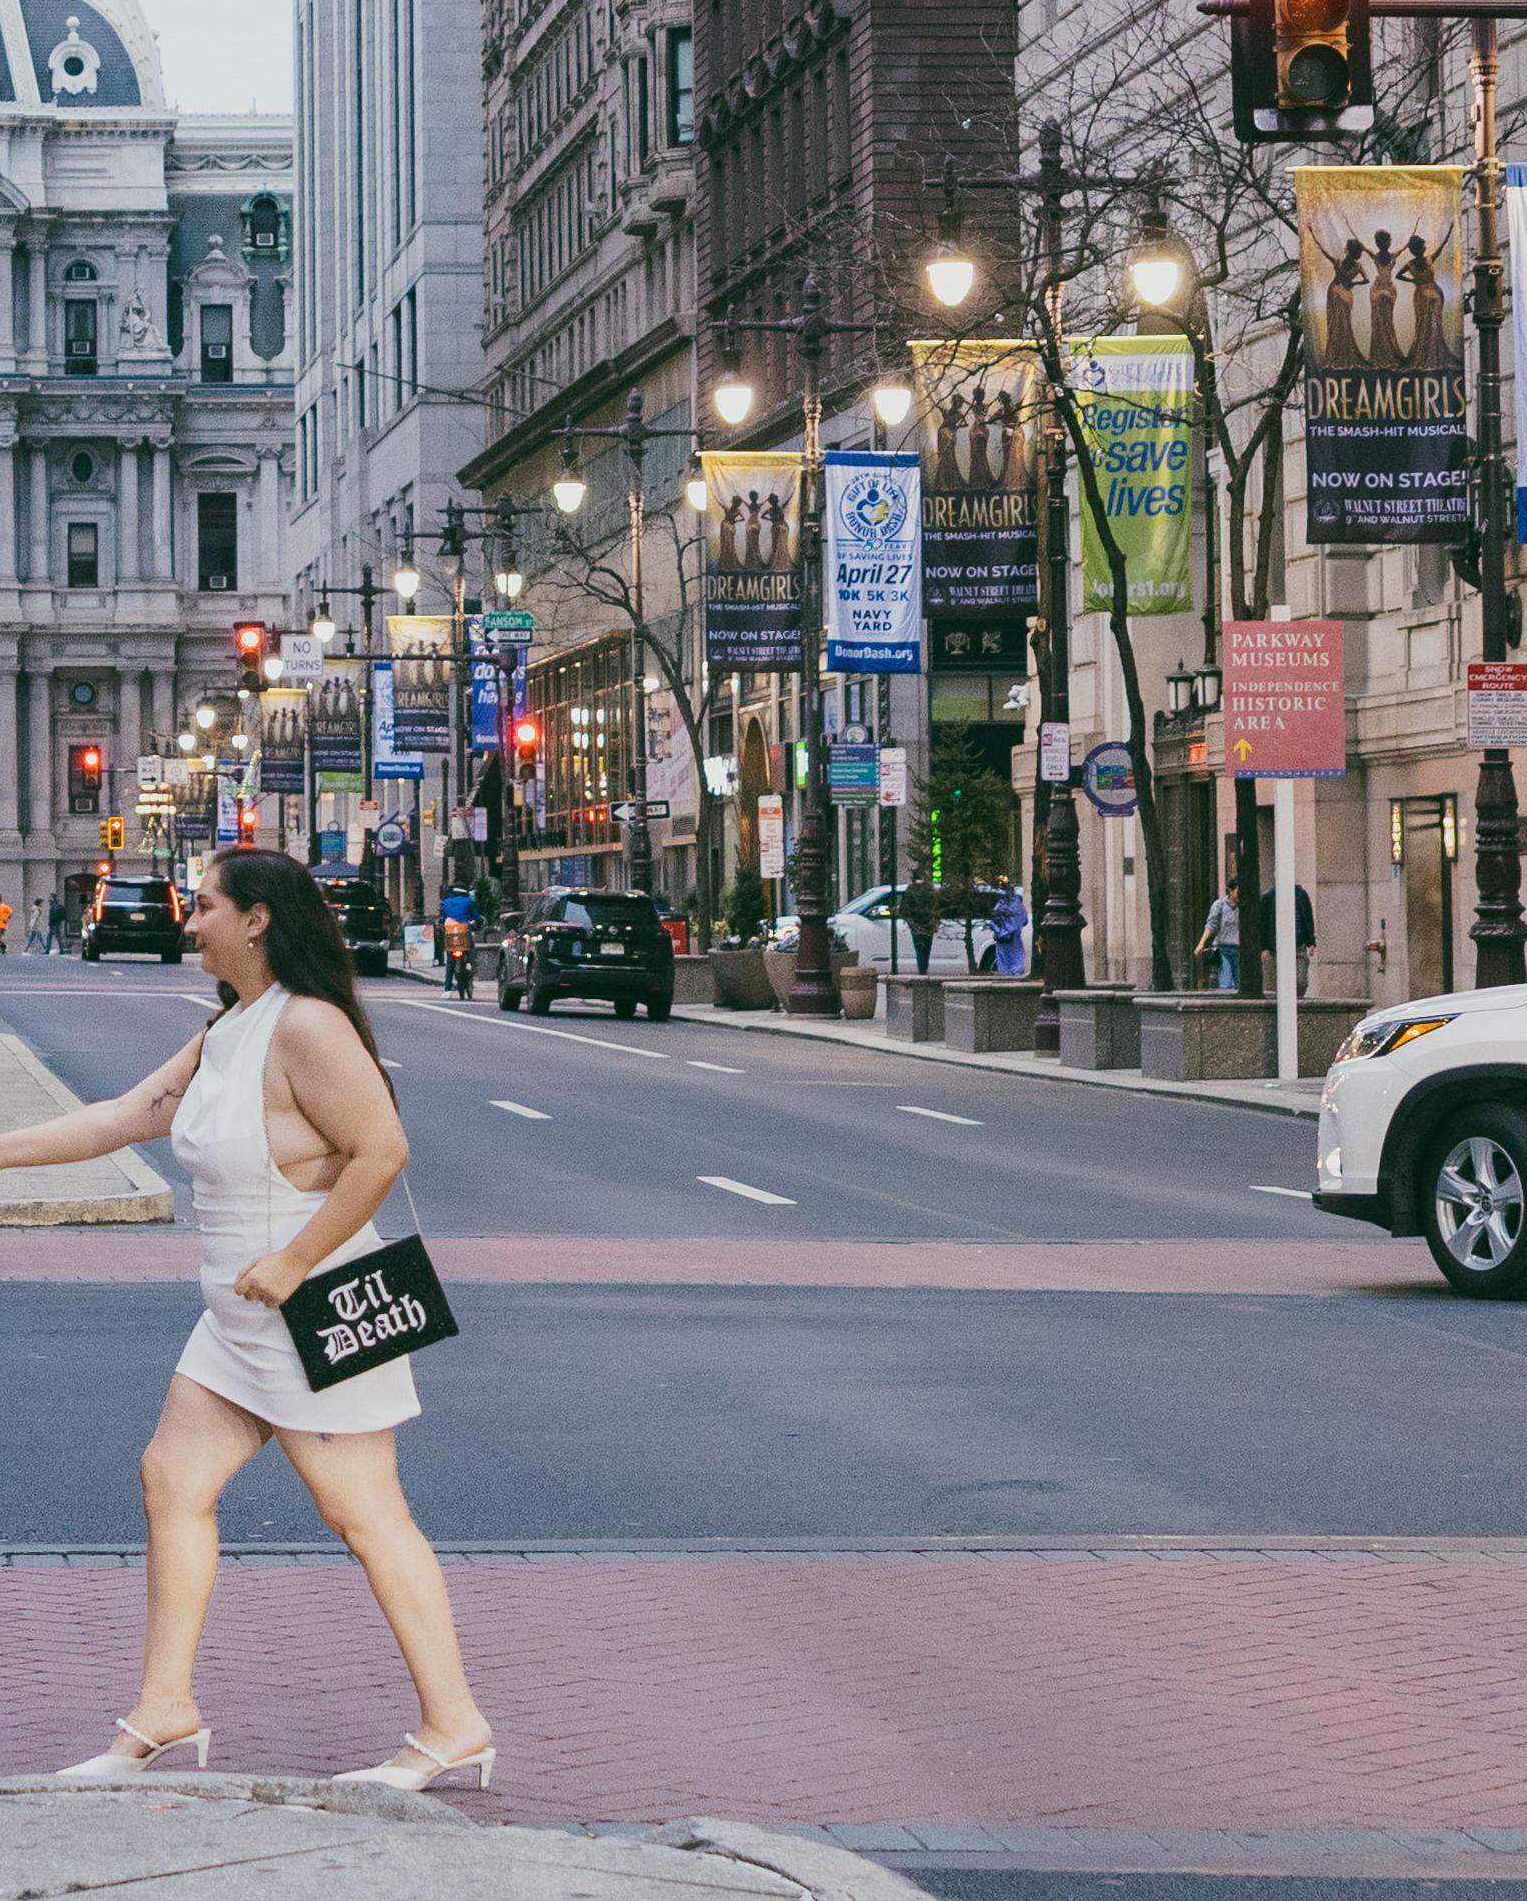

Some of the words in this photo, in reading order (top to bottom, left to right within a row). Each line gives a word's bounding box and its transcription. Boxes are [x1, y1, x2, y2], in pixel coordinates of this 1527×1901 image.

[1308, 375, 1466, 420] DREAMGIRLS
[1309, 426, 1335, 437] THE
[1337, 426, 1405, 437] SMASH-HIT
[1105, 441, 1188, 473] save
[1312, 472, 1361, 488] NOW
[1364, 472, 1393, 488] ON
[1398, 470, 1466, 488] STAGE!
[1107, 478, 1185, 517] lives
[1386, 499, 1423, 514] STREET
[1357, 515, 1378, 524] AND
[1380, 514, 1426, 524] WALNUT
[837, 564, 883, 587] April
[885, 565, 912, 584] 27
[926, 566, 963, 578] NOW
[966, 566, 988, 577] ON
[708, 574, 800, 600] DREAMGIRLS
[867, 590, 884, 601] 5K
[853, 610, 892, 619] NAVY
[854, 621, 892, 631] YARD
[709, 631, 737, 640] NOW
[741, 631, 757, 640] ON
[1232, 633, 1325, 648] PARKWAY
[293, 641, 311, 654] NO
[835, 645, 913, 660] DonorDash.org
[285, 660, 320, 671] TURNS
[1232, 652, 1330, 667] MUSEUMS
[1232, 682, 1340, 692] INDEPENDENCE
[1232, 697, 1327, 711] HISTORIC
[1233, 716, 1286, 730] AREA
[328, 1269, 392, 1320] Til
[317, 1294, 426, 1365] Death
